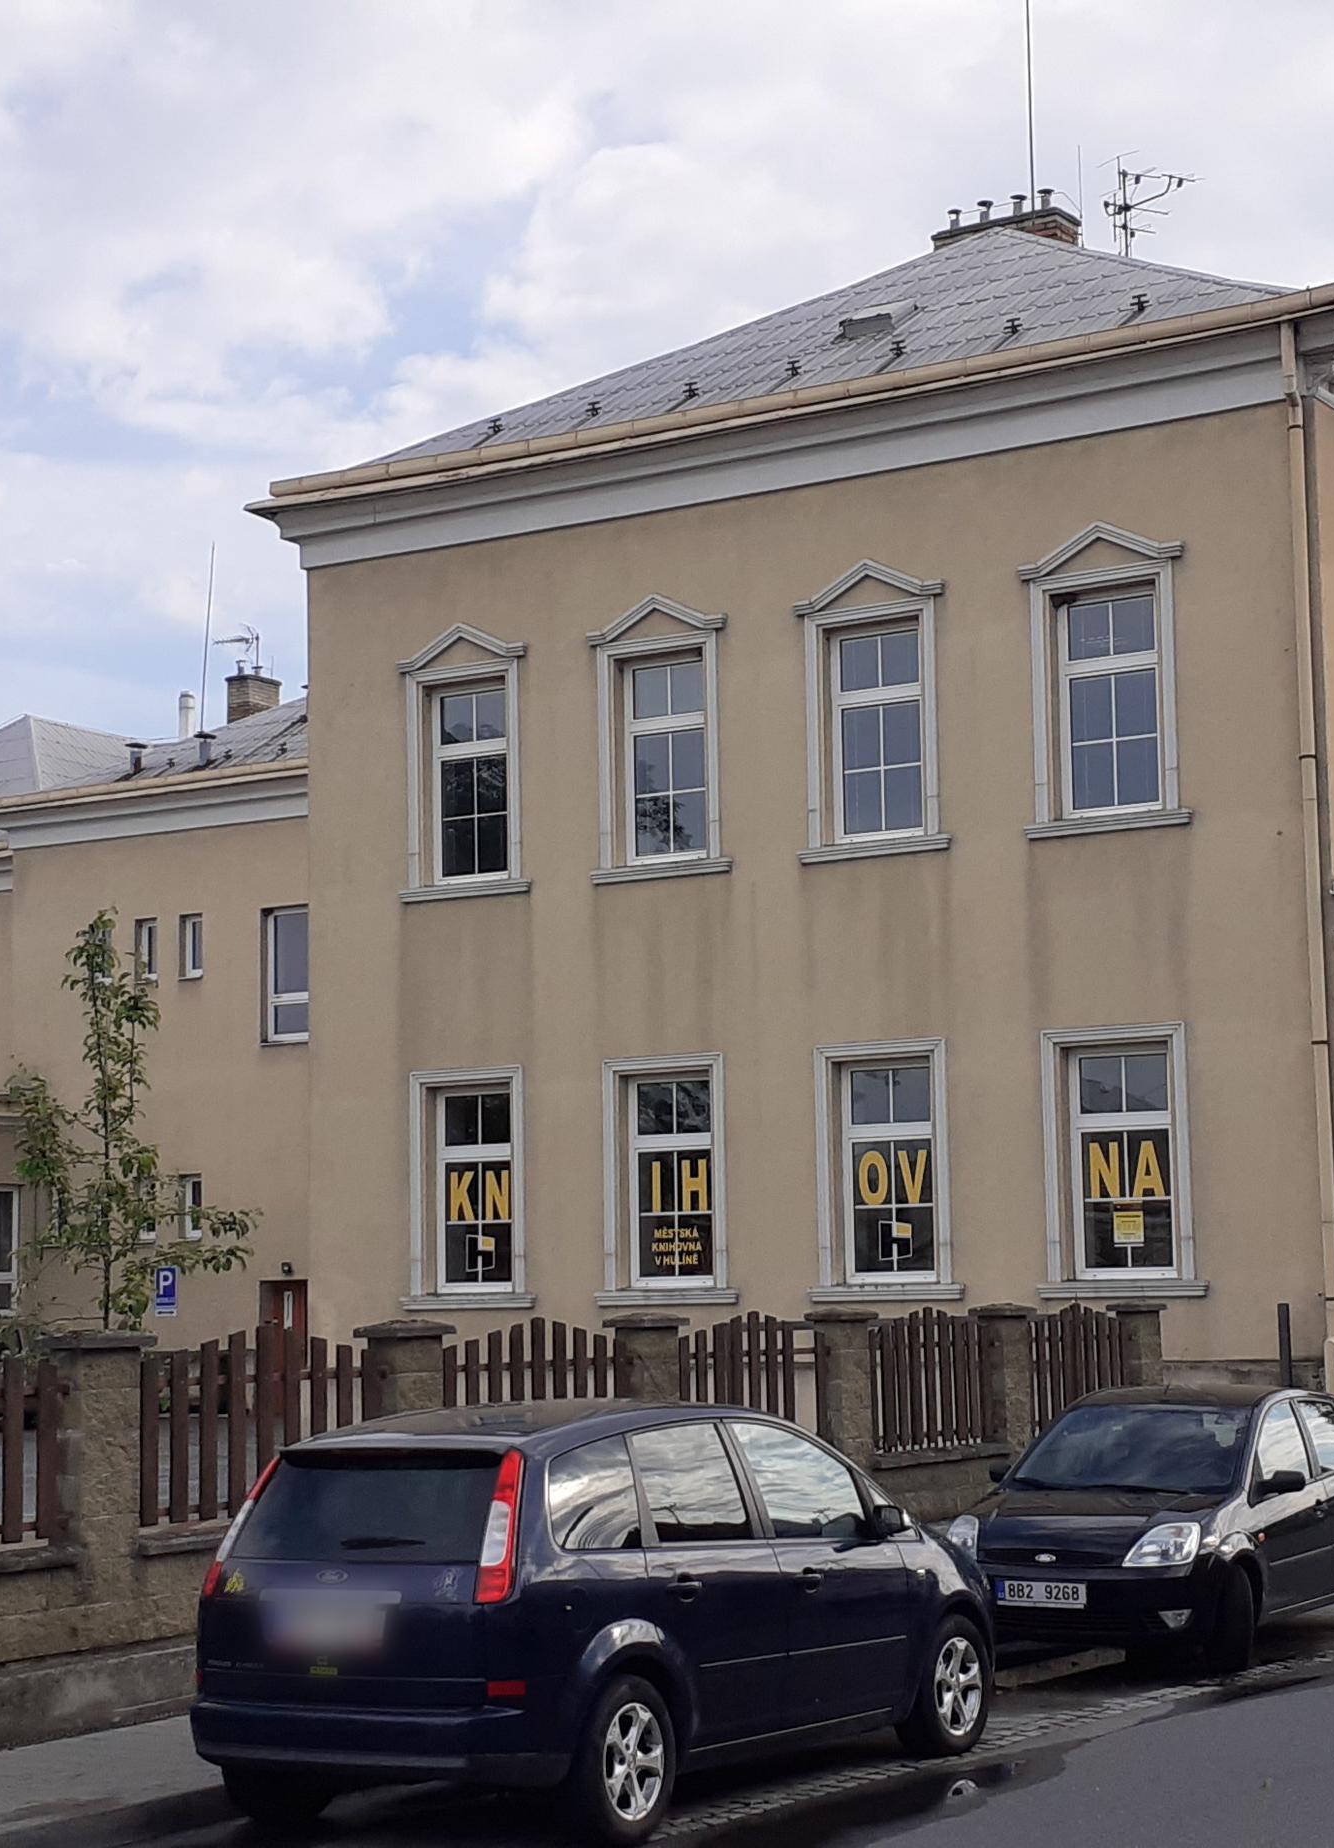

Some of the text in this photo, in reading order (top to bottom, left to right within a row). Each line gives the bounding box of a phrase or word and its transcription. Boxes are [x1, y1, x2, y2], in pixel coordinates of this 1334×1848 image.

[653, 1225, 700, 1239] MĚSTSKÁ
[651, 1241, 703, 1252] KNIHOVNA
[159, 1270, 173, 1295] P
[1008, 1583, 1080, 1601] 8B2 9268
